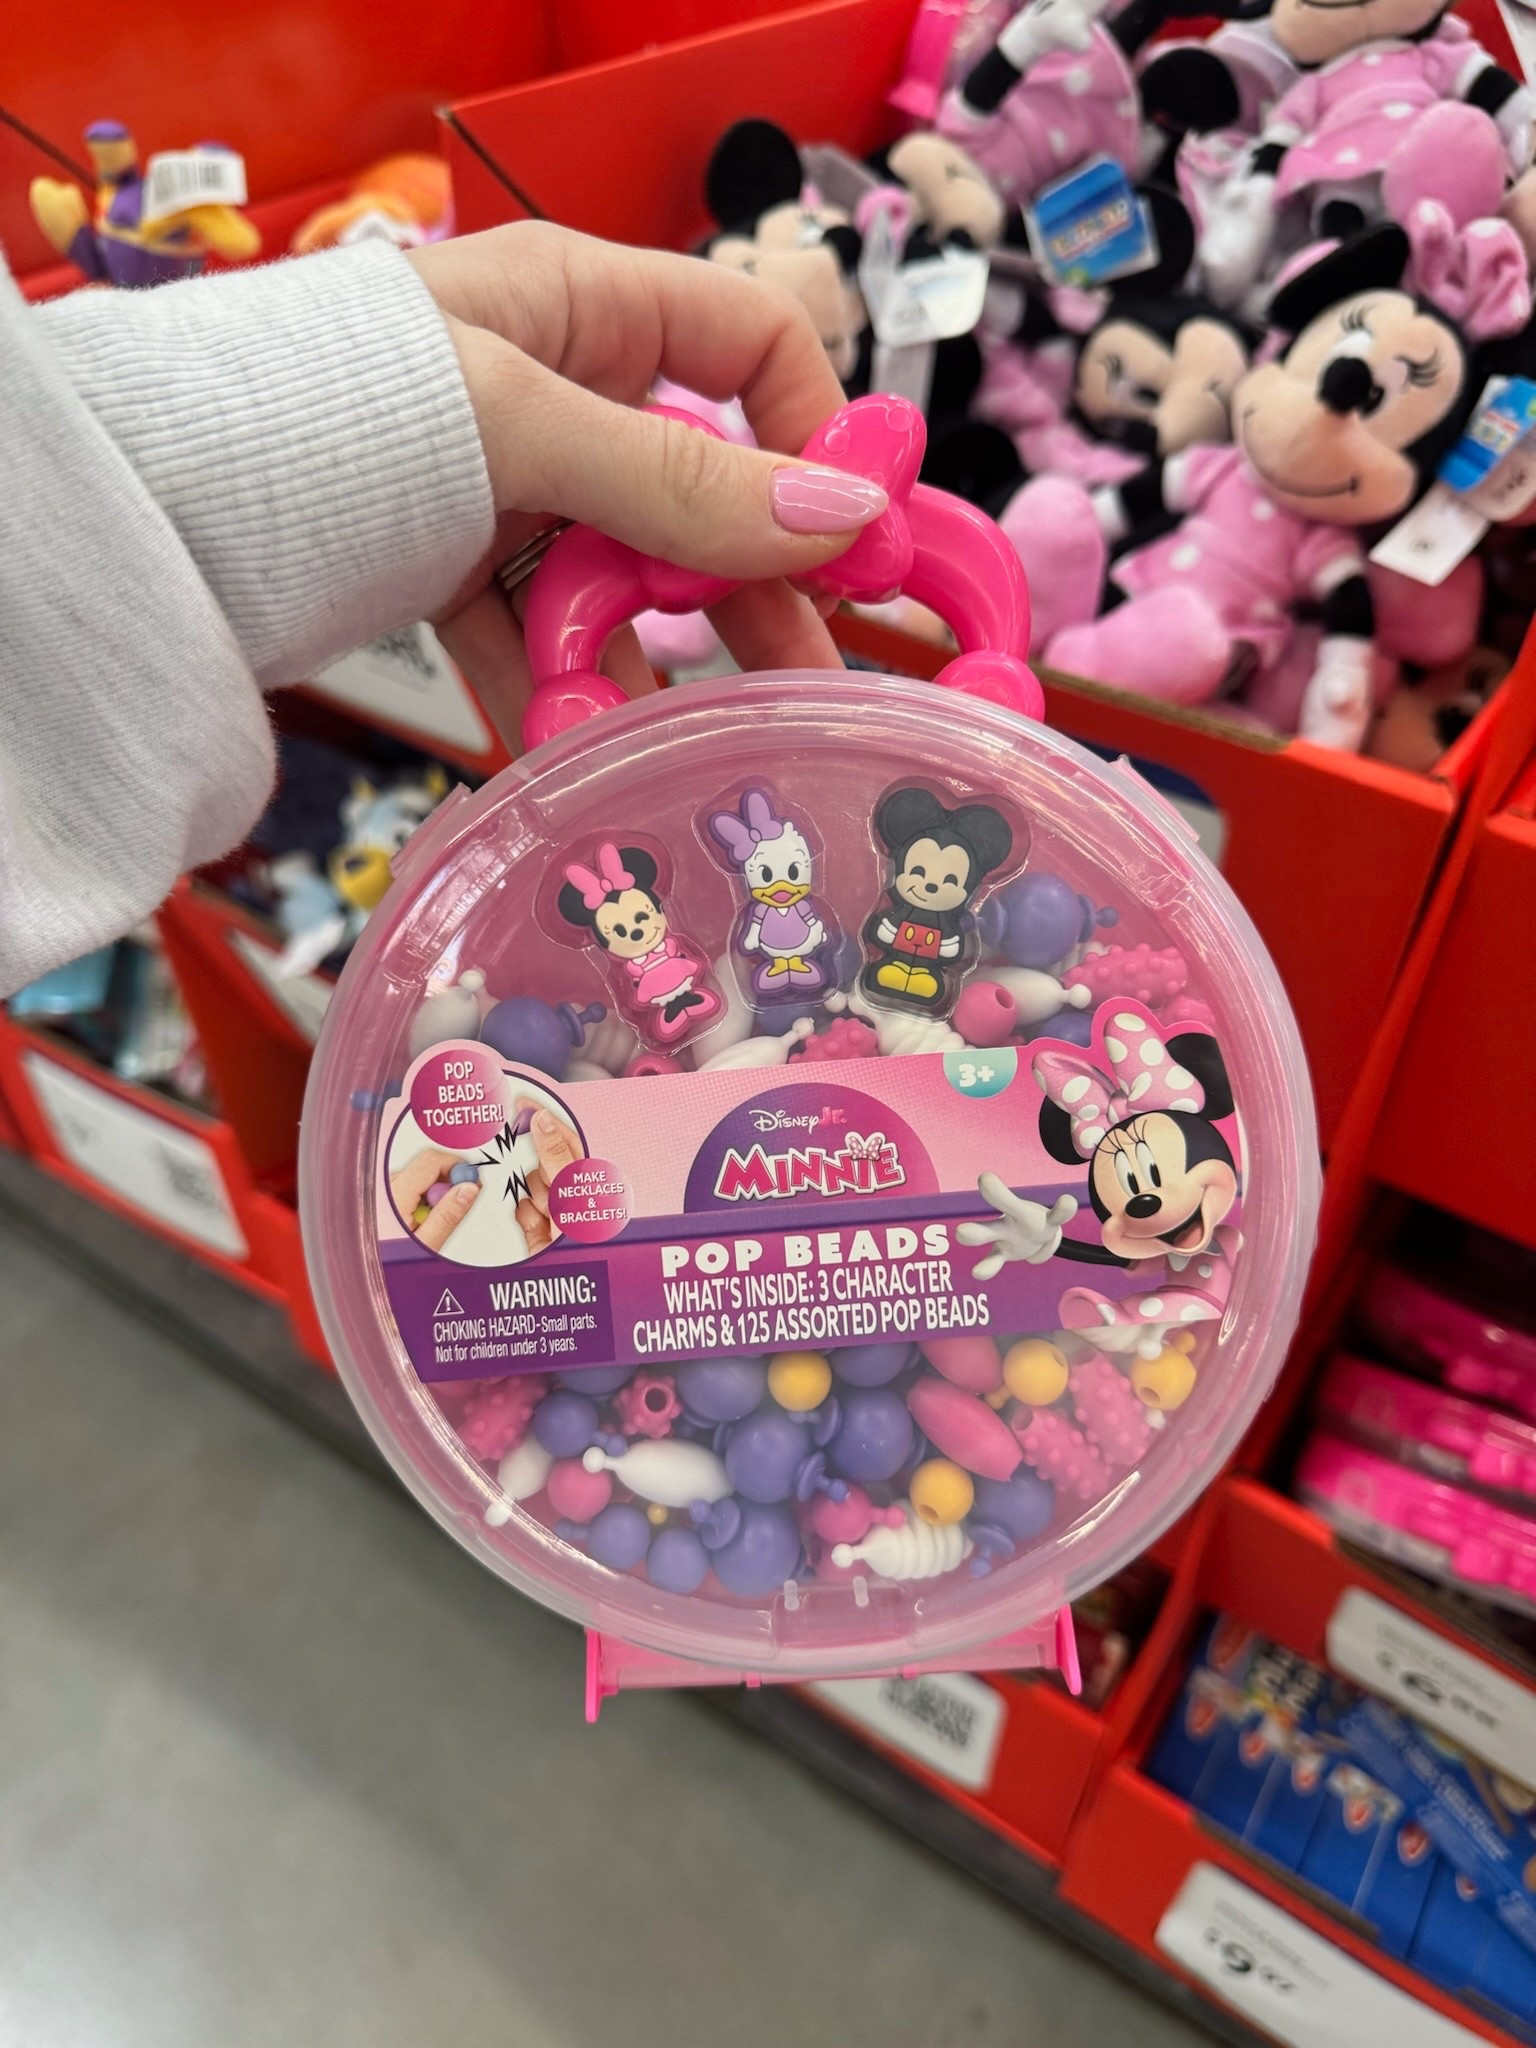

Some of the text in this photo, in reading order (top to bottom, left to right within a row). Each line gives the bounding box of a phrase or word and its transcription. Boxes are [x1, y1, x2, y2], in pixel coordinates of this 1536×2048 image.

[444, 1061, 474, 1080] POP
[958, 1063, 995, 1088] 3+
[438, 1083, 485, 1103] BEADS
[423, 1104, 504, 1127] TOGETHER!
[749, 1109, 819, 1134] Disney
[573, 1170, 606, 1184] MAKE
[714, 1143, 906, 1201] MINNIE
[558, 1183, 624, 1198] NECKLACES
[587, 1198, 597, 1208] &
[560, 1208, 627, 1224] BRACELETS!
[661, 1224, 950, 1278] POP BEADS
[489, 1275, 597, 1311] WARNING:
[663, 1260, 953, 1314] WHAT'S INSIDE: 3 CHARACTER
[433, 1318, 486, 1343] CHOKING
[570, 1312, 598, 1334] parts.
[633, 1293, 990, 1353] CHARMS & 125 ASSORTED POP BEADS
[436, 1337, 578, 1363] Not for children under 3 years.
